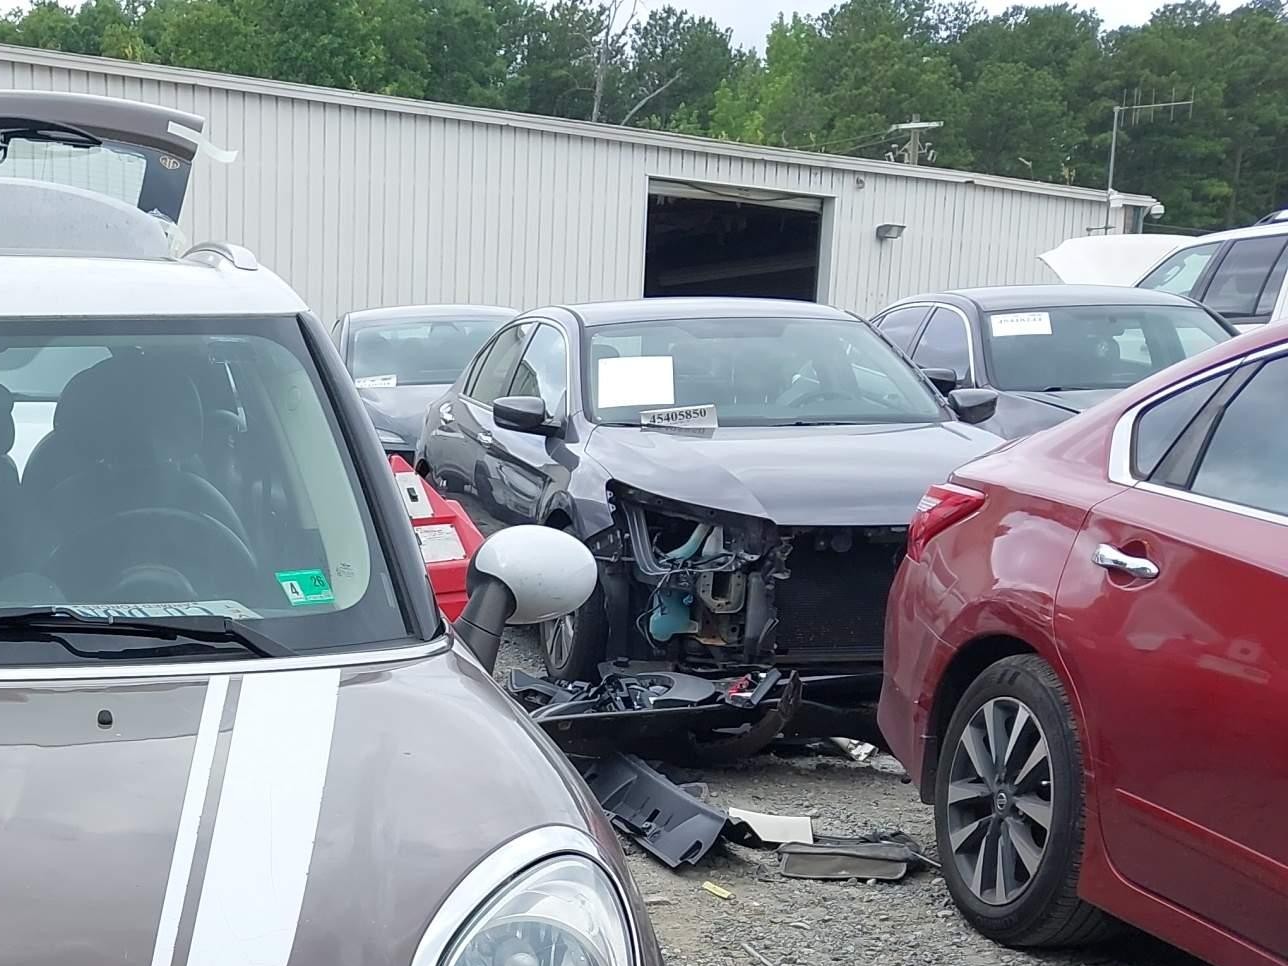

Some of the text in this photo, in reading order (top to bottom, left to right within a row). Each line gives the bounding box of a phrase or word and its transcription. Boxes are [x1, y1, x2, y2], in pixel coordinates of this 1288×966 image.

[649, 408, 707, 424] 45405850
[311, 575, 325, 588] 26
[289, 583, 300, 597] 4
